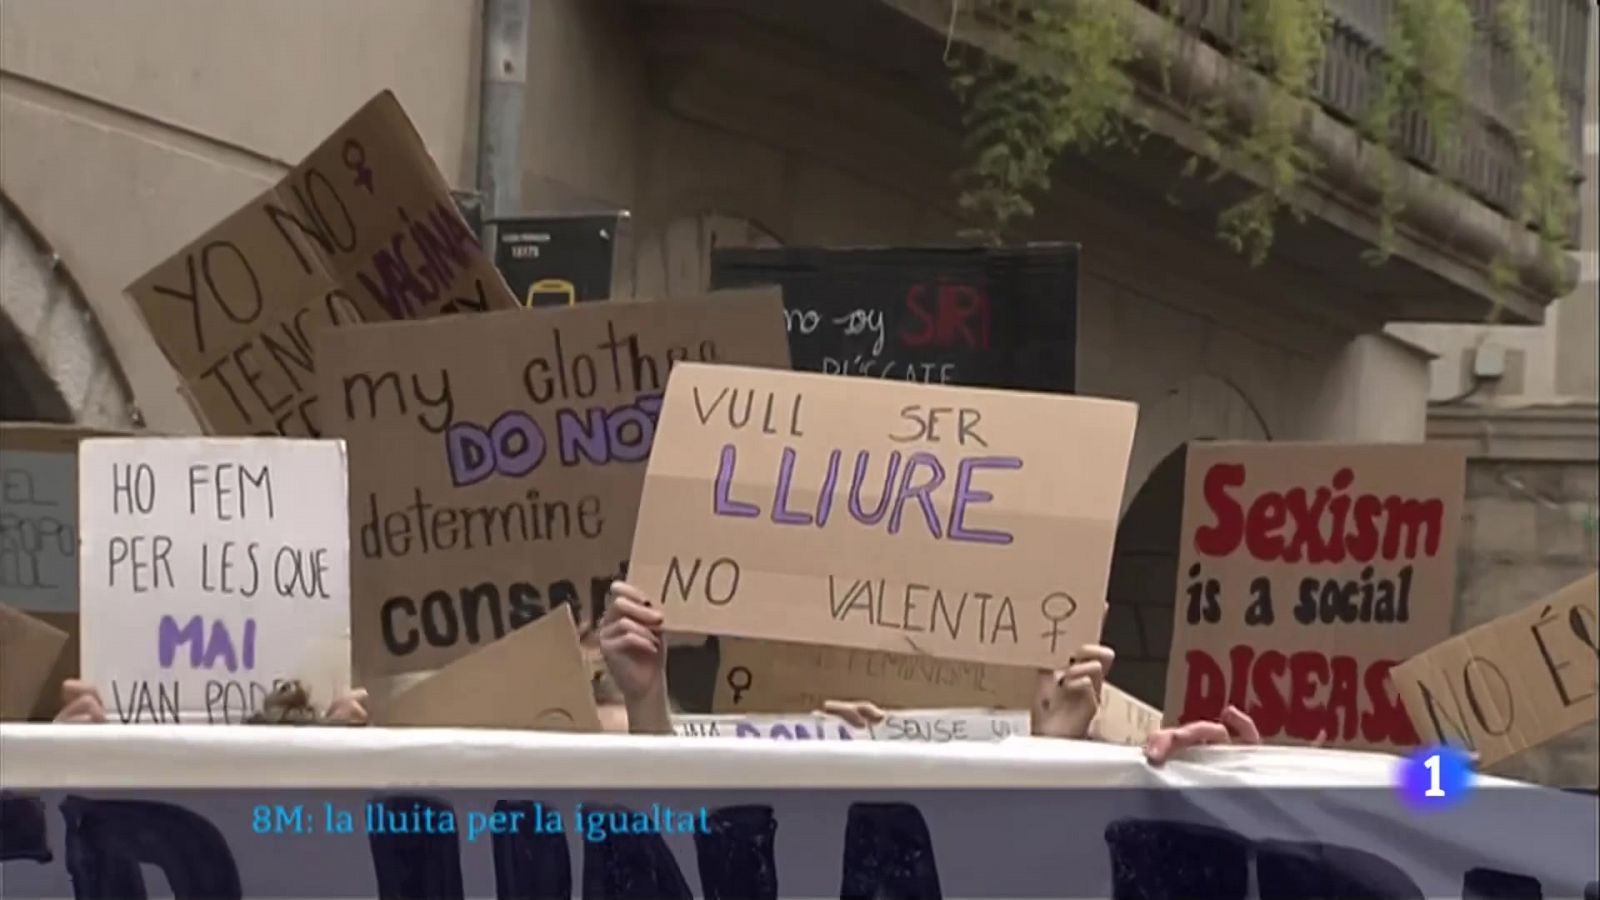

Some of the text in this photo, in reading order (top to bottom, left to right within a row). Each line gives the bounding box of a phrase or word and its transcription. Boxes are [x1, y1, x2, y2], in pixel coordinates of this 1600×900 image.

[153, 168, 357, 352] YO NO
[342, 368, 455, 435] my
[693, 386, 989, 447] VULL SER
[445, 410, 548, 488] DO
[112, 462, 274, 521] HO FEM
[360, 488, 605, 561] determine
[713, 443, 1024, 546] LLIURE
[1194, 463, 1445, 564] Sexism
[108, 535, 331, 600] PER LES QUE
[660, 556, 1019, 645] NO VALENTA
[1186, 562, 1415, 627] is a social
[158, 614, 257, 674] MAI
[381, 560, 629, 657] cons
[112, 680, 181, 725] VAN
[1417, 655, 1515, 753] NO
